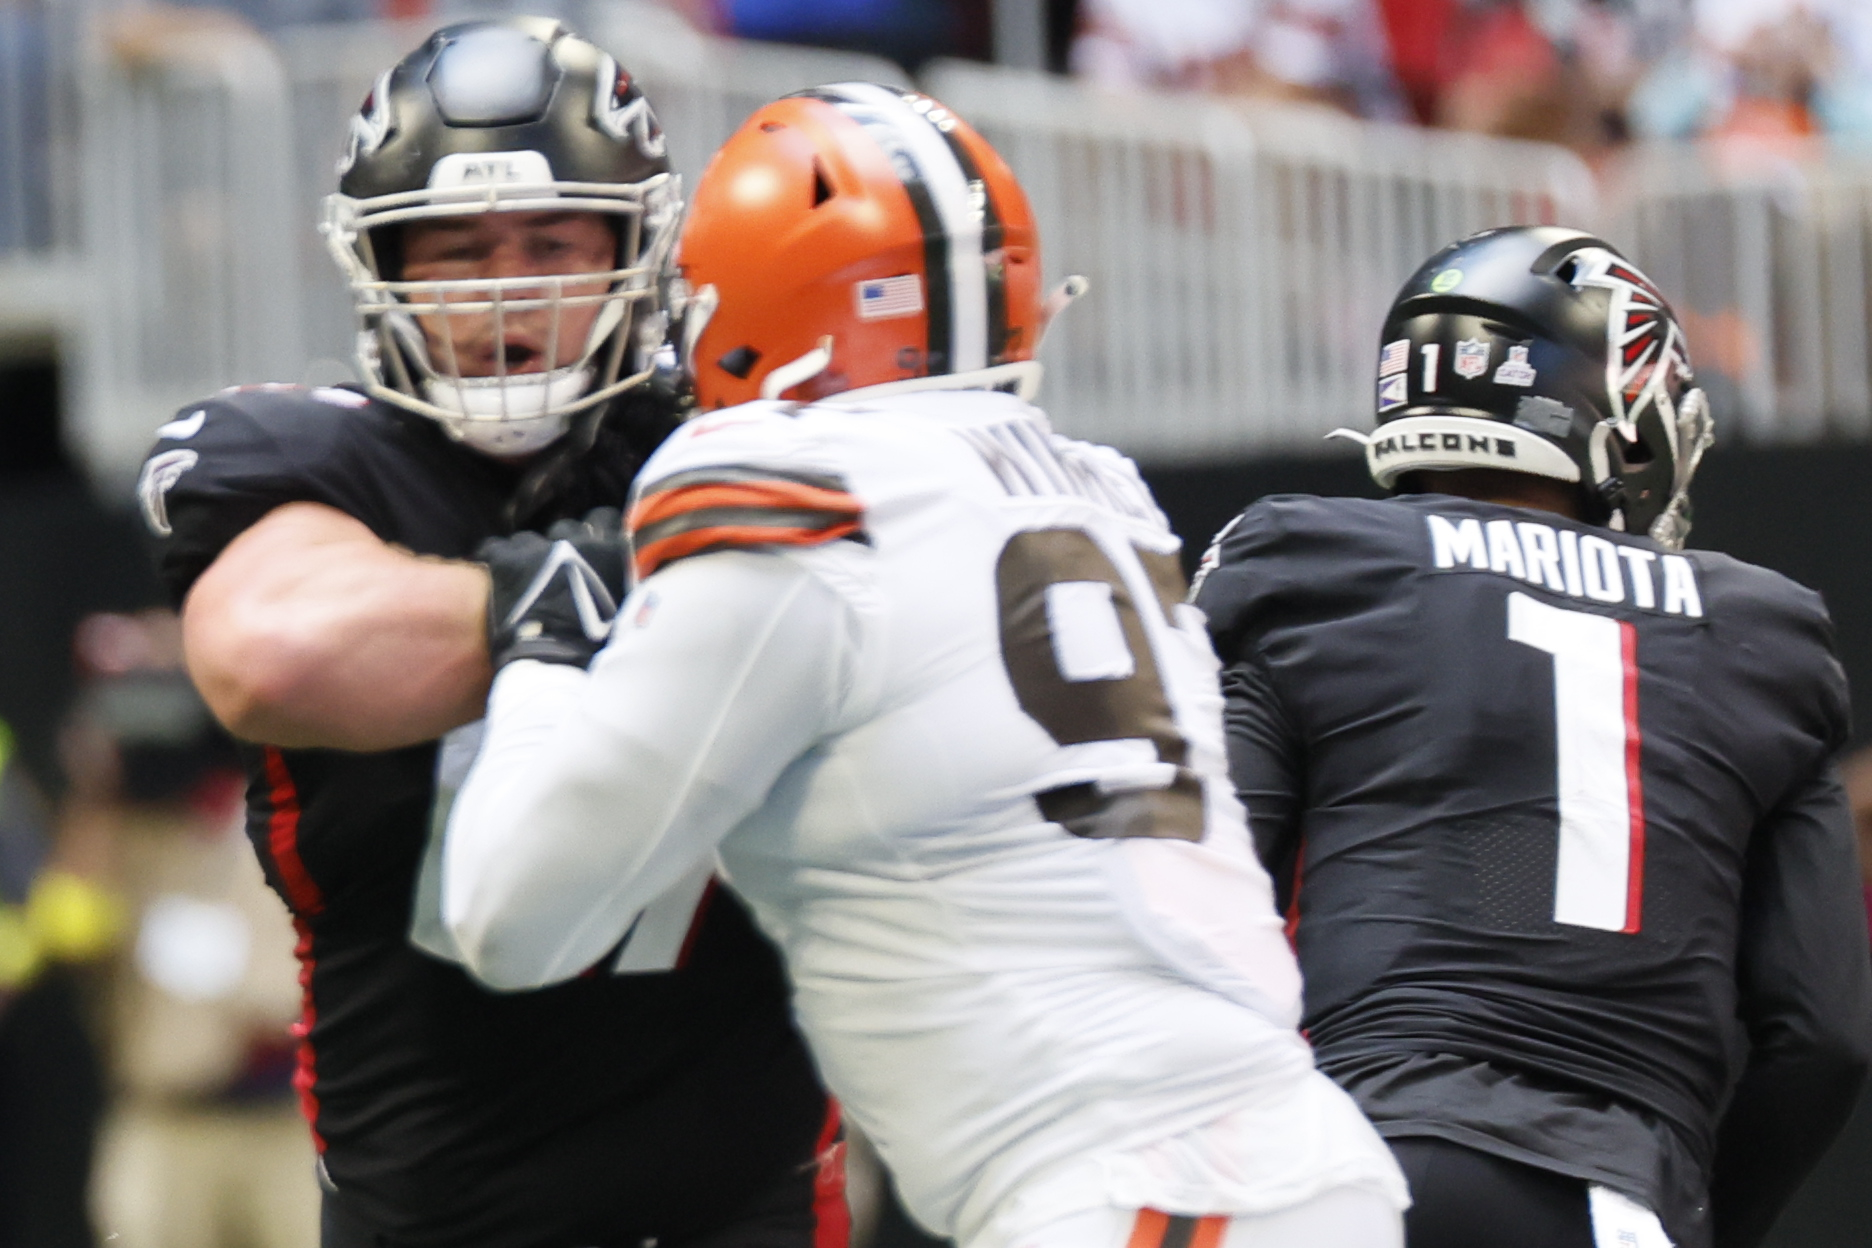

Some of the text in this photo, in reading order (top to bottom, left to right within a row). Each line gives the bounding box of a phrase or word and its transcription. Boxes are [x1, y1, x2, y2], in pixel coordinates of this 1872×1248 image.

[1420, 343, 1442, 393] 1
[1375, 432, 1516, 459] FALCONS
[1426, 514, 1704, 618] MARIOTA
[995, 527, 1206, 842] 9
[1507, 591, 1646, 934] 1
